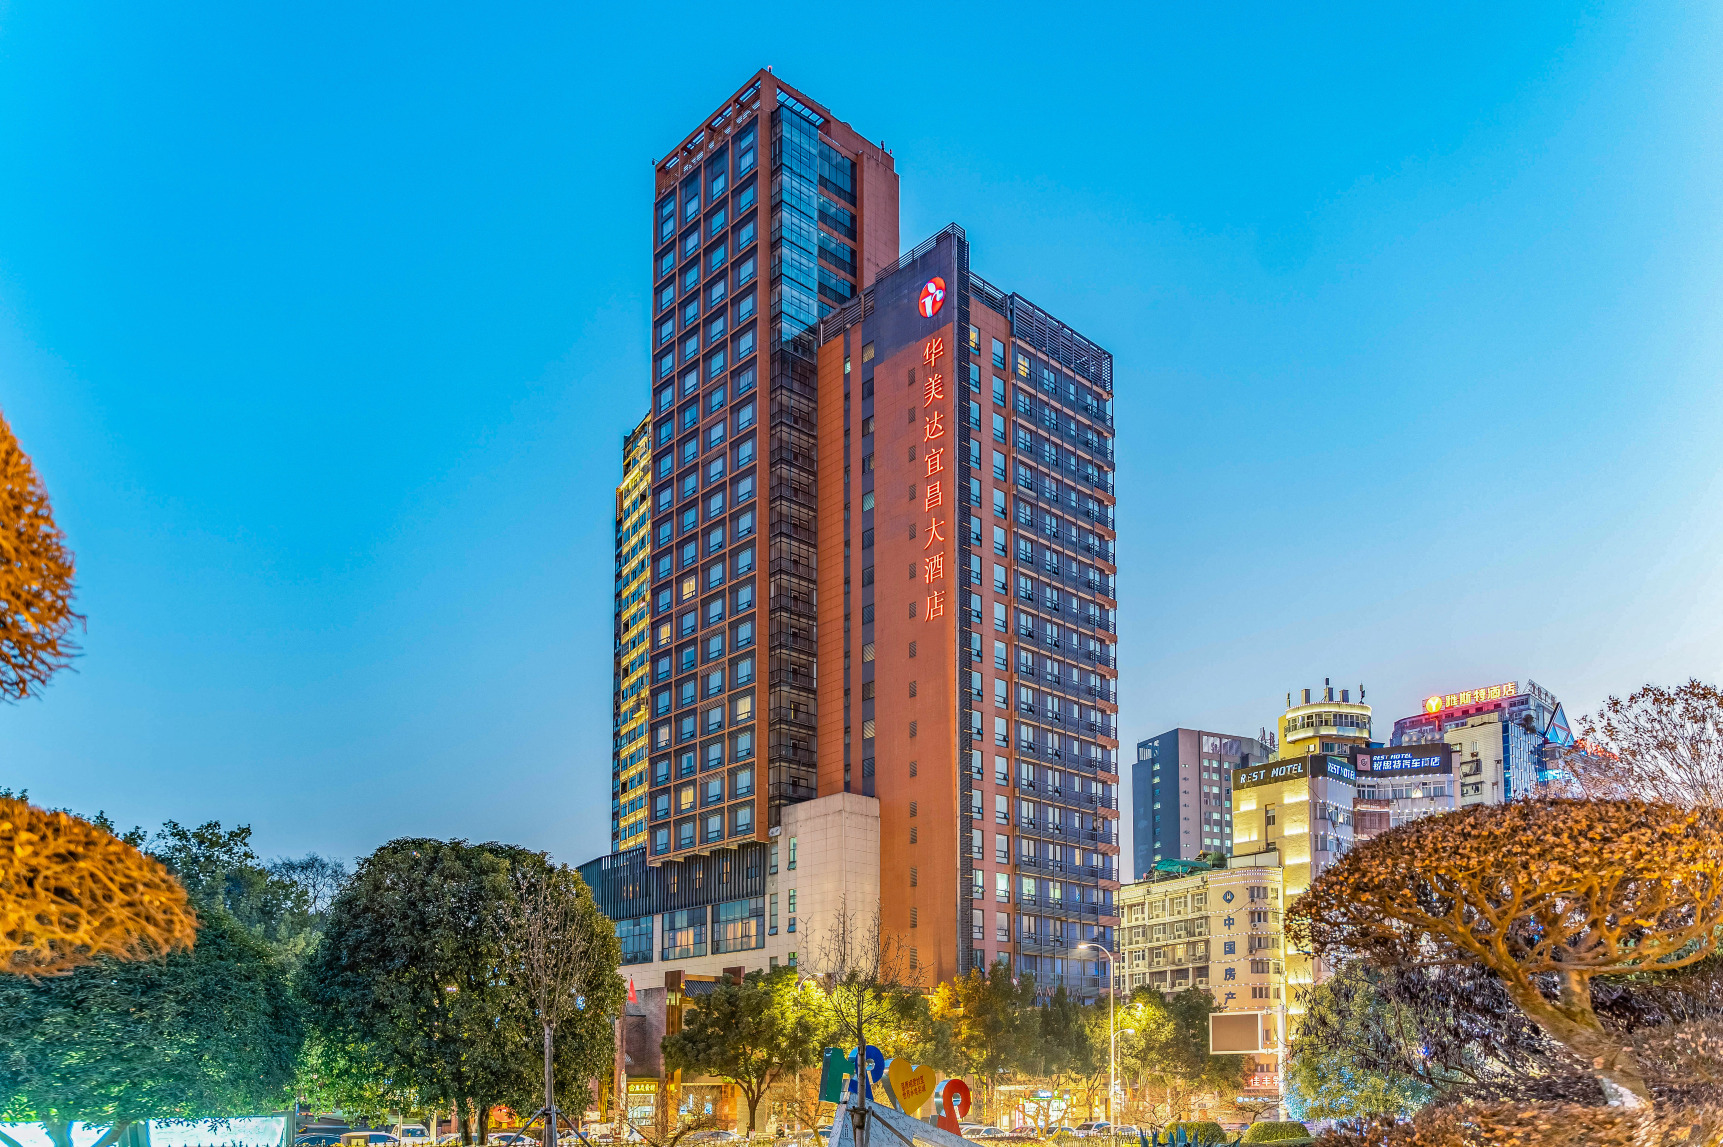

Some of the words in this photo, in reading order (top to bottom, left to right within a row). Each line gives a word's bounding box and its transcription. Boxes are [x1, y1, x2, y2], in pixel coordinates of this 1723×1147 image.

[922, 337, 945, 622] 华美达宜昌大酒店
[1445, 682, 1516, 708] 雅斯特酒店
[1240, 769, 1266, 784] REST
[1271, 762, 1304, 778] MOTEL
[1327, 762, 1341, 775] REST
[1223, 915, 1237, 1006] 中国房产
